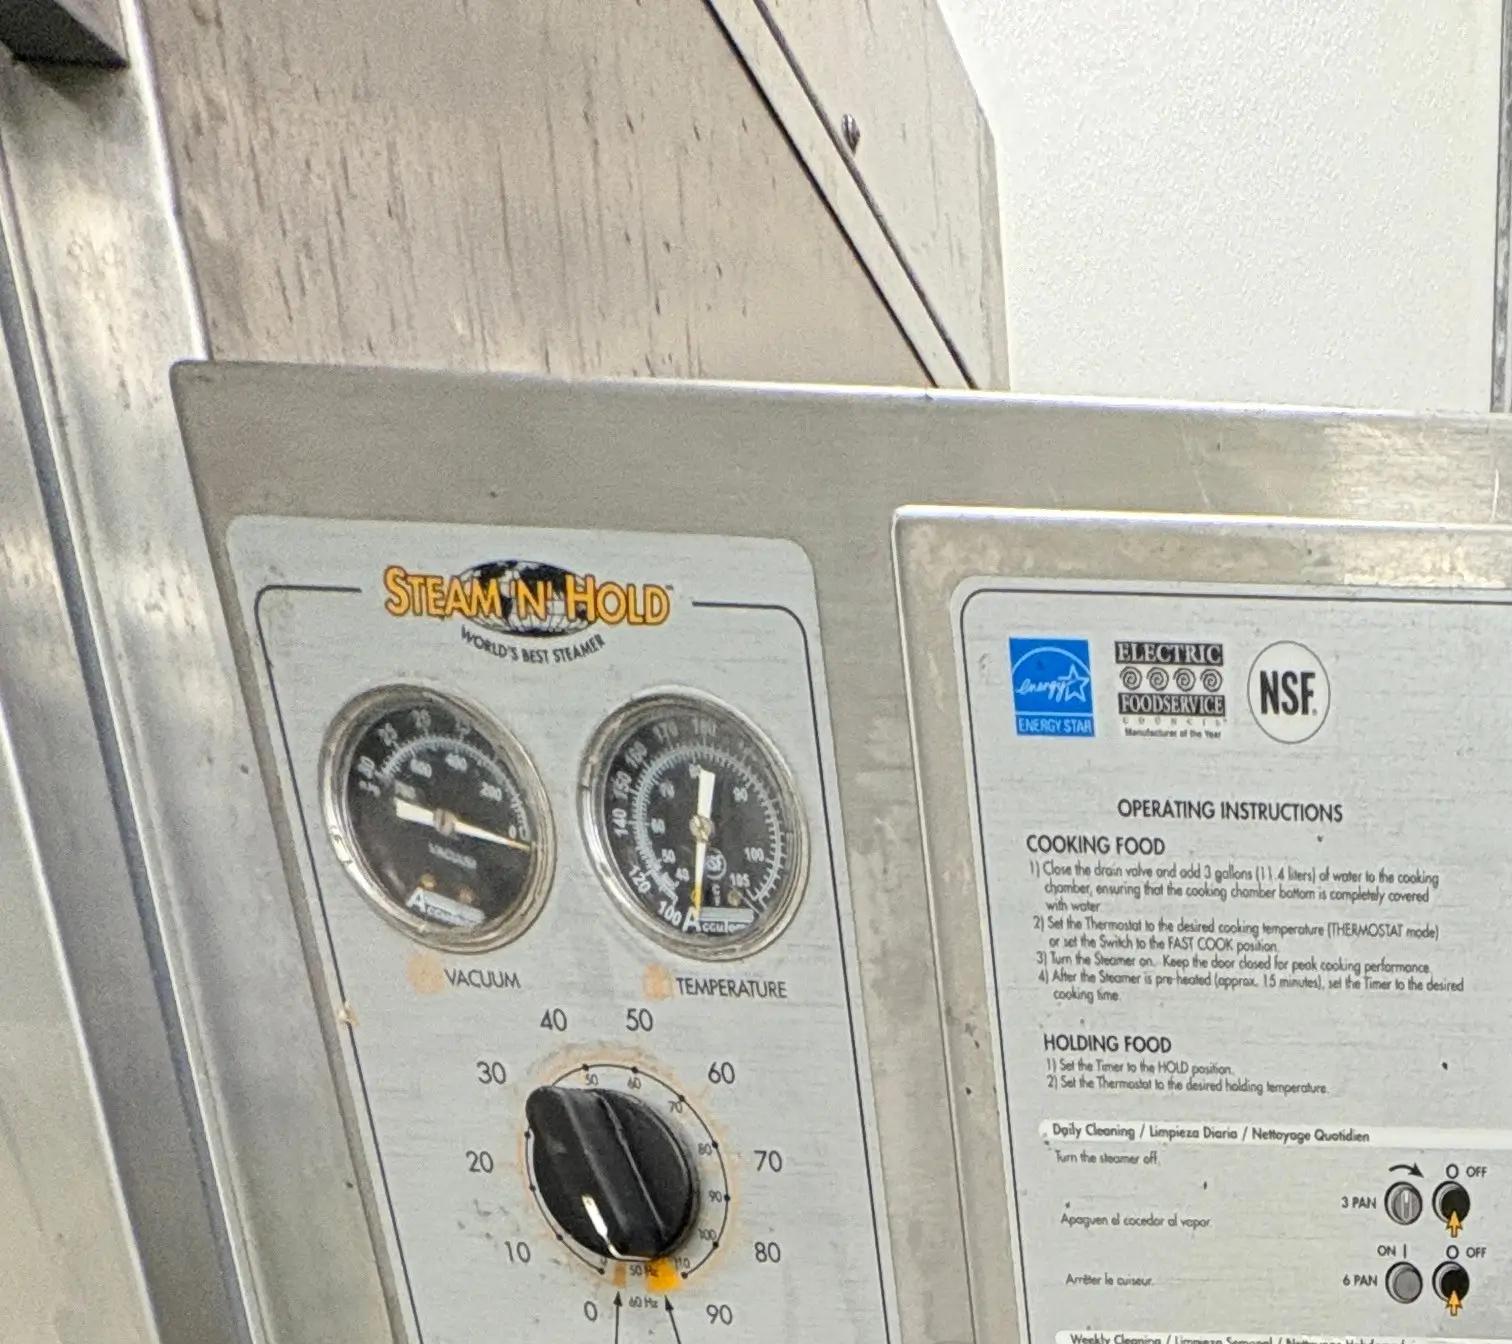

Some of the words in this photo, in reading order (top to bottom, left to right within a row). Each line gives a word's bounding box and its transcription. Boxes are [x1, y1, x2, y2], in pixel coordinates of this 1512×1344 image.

[384, 565, 502, 619] STEAM
[566, 574, 669, 625] HOLD
[461, 624, 519, 662] WORLD'S
[522, 648, 548, 663] BEST
[554, 633, 606, 664] STEAMER
[1117, 643, 1222, 663] ELECTRIC
[1260, 671, 1316, 715] NSF
[1121, 695, 1223, 713] FOODSERVICE
[1019, 719, 1063, 732] ENERGY
[1065, 720, 1092, 732] STAR
[1117, 799, 1215, 819] OPERATING
[1221, 802, 1343, 823] INSTRUCTIONS
[1026, 834, 1110, 855] COOKING
[1116, 837, 1165, 855] FOOD
[444, 969, 521, 988] VACUUM
[676, 977, 787, 998] TEMPERATURE
[540, 1008, 567, 1031] 40
[626, 1008, 653, 1032] 50
[1044, 1034, 1119, 1052] HOLDING
[1124, 1036, 1171, 1053] FOOD
[477, 1061, 506, 1085] 30
[708, 1062, 735, 1084] 60
[1060, 1058, 1075, 1071] Set
[1078, 1058, 1093, 1072] the
[1096, 1059, 1123, 1073] Timer
[1127, 1062, 1137, 1073] to
[1140, 1059, 1155, 1074] the
[1158, 1060, 1189, 1074] HOLD
[1053, 1122, 1081, 1139] Daily
[1085, 1123, 1135, 1141] Cleaning
[1150, 1125, 1199, 1141] Limpieza
[1203, 1126, 1238, 1139] Diaria
[1252, 1127, 1311, 1145] Nettoyage
[1314, 1128, 1369, 1142] Quotidien
[466, 1151, 494, 1173] 20
[754, 1150, 782, 1173] 70
[1055, 1149, 1077, 1163] Turn
[1080, 1150, 1096, 1163] the
[1100, 1153, 1139, 1164] steamer
[1466, 1166, 1486, 1178] OFF
[1342, 1196, 1349, 1208] 3
[1352, 1197, 1376, 1209] PAN
[504, 1241, 531, 1263] 10
[754, 1241, 781, 1263] 80
[1377, 1245, 1396, 1256] ON
[1466, 1247, 1486, 1258] OFF
[1343, 1274, 1350, 1286] 6
[1354, 1275, 1377, 1286] PAN
[584, 1301, 598, 1322] 0
[706, 1304, 733, 1325] 90
